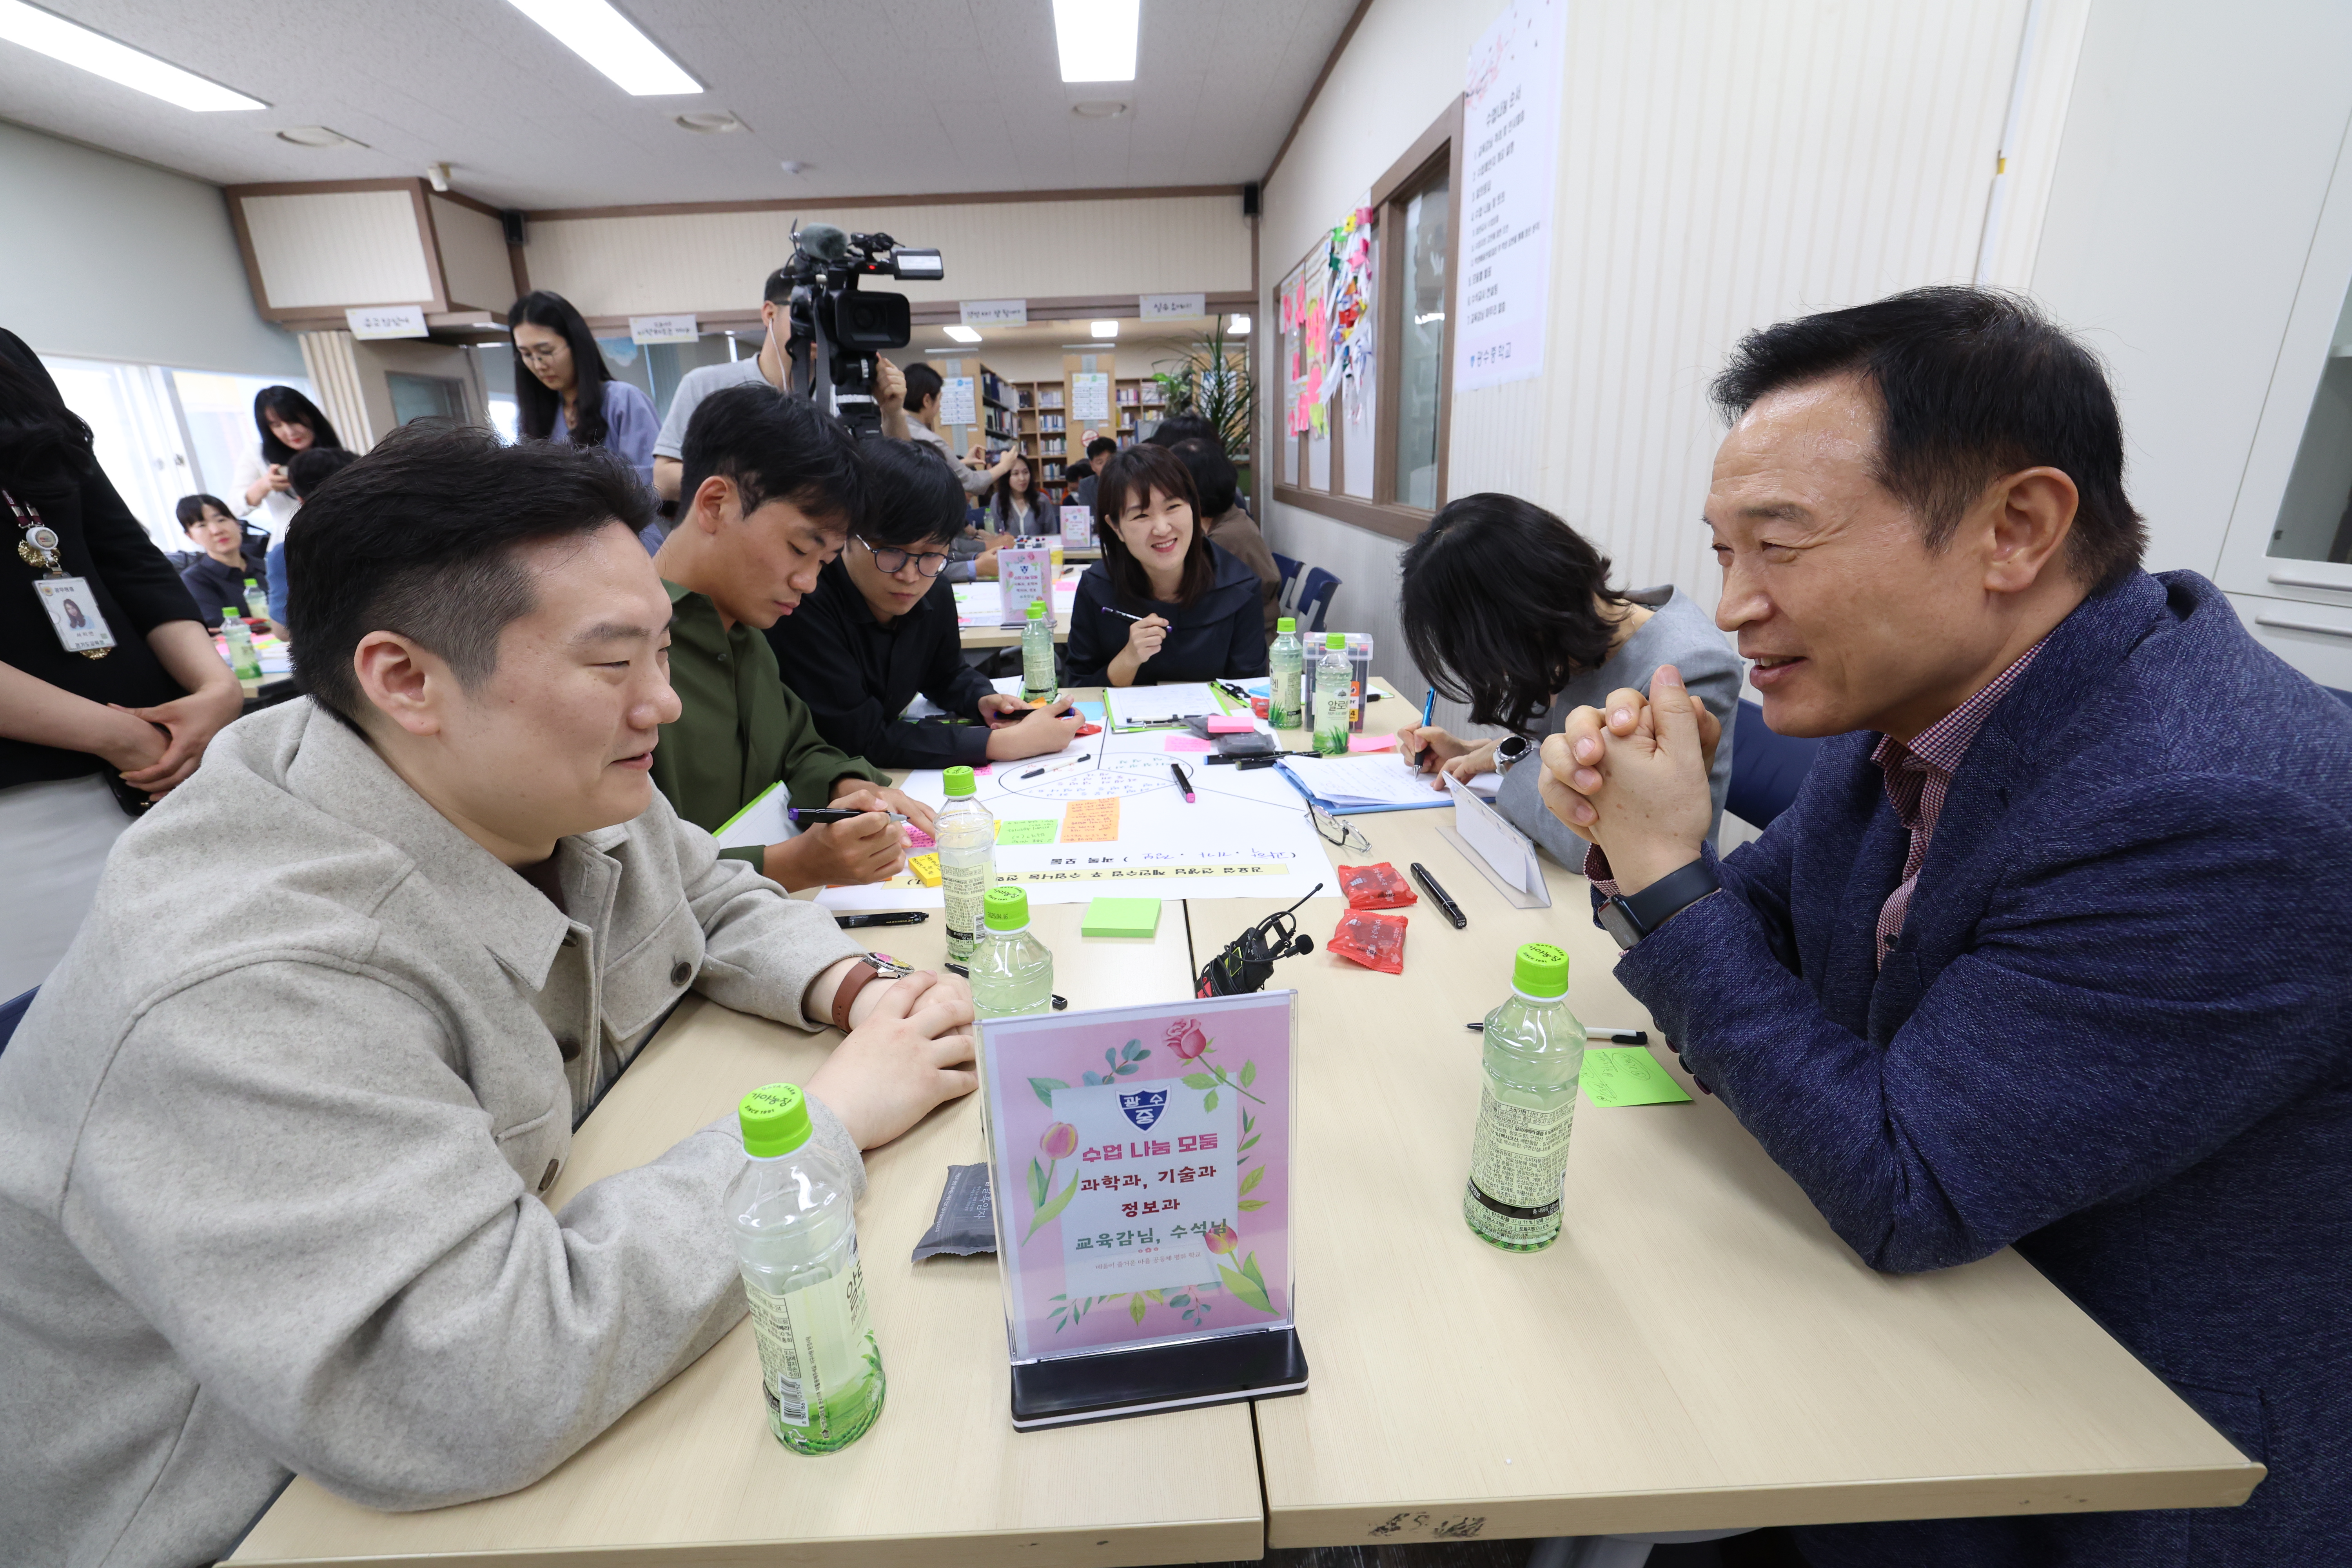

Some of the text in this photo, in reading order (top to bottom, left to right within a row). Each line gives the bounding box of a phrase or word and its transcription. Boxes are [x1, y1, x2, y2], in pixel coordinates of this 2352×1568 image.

[994, 889, 1019, 898] 가야농장
[1528, 945, 1562, 962] 가야농장
[751, 1093, 792, 1107] 가야농장
[745, 1105, 759, 1114] SINCE
[1135, 1108, 1154, 1124] 중
[1515, 1126, 1544, 1136] 알로에베라겔즙
[1082, 1133, 1218, 1163] 수업 나눔 모둠
[1081, 1165, 1216, 1191] 과학과, 기술과
[1517, 1169, 1546, 1178] 냉장보관하시고
[1468, 1179, 1481, 1200] 영양정보
[1517, 1179, 1542, 1187] 손상되었거나
[1121, 1198, 1181, 1218] 정보과
[1483, 1214, 1505, 1227] 트랜스지방
[1492, 1211, 1510, 1222] 탄수화물
[1075, 1218, 1227, 1250] 교육감님, 수석님
[1153, 1256, 1172, 1264] 공동체
[851, 1302, 859, 1325] PULPY
